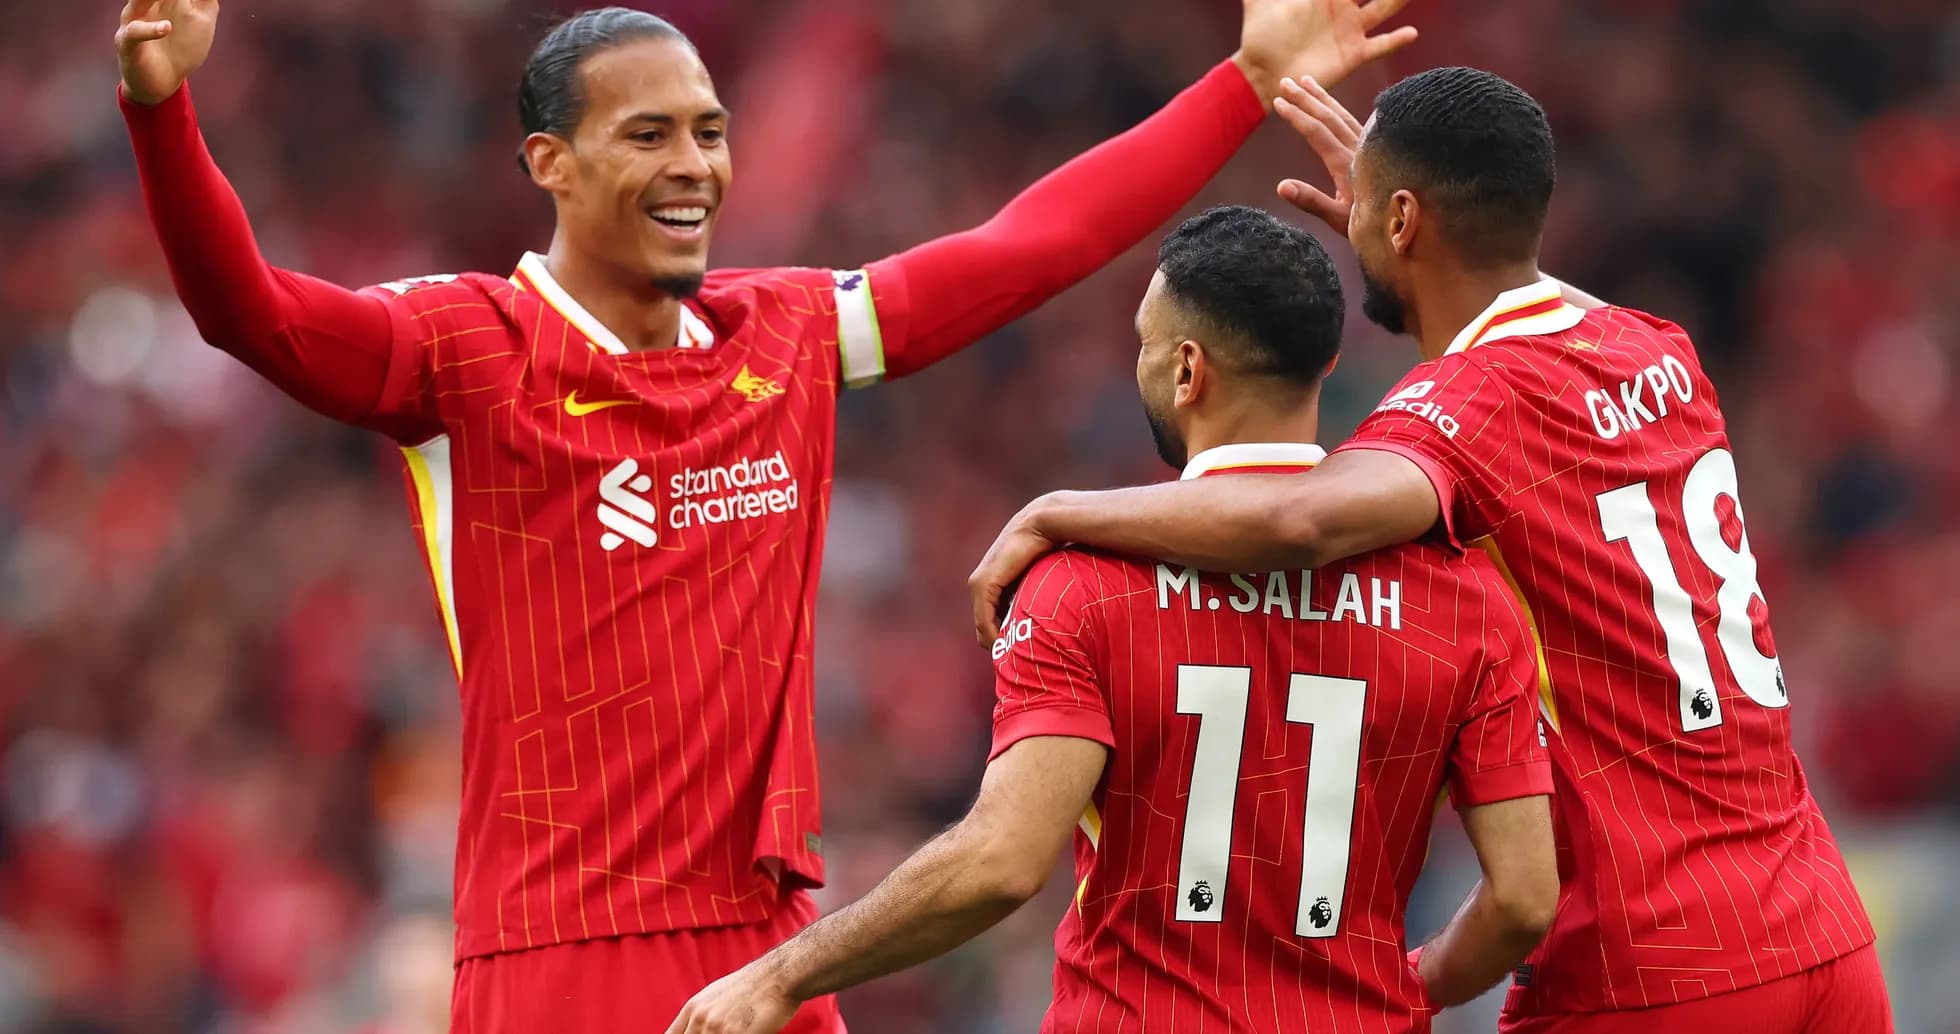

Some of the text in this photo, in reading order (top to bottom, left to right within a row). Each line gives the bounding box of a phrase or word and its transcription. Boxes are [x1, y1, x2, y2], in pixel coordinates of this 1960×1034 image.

[1378, 400, 1460, 439] edia
[670, 450, 790, 498] standard
[669, 480, 798, 529] chartered
[1156, 563, 1401, 630] M.SALAH
[1595, 447, 1789, 732] 18
[1175, 664, 1368, 938] 11
